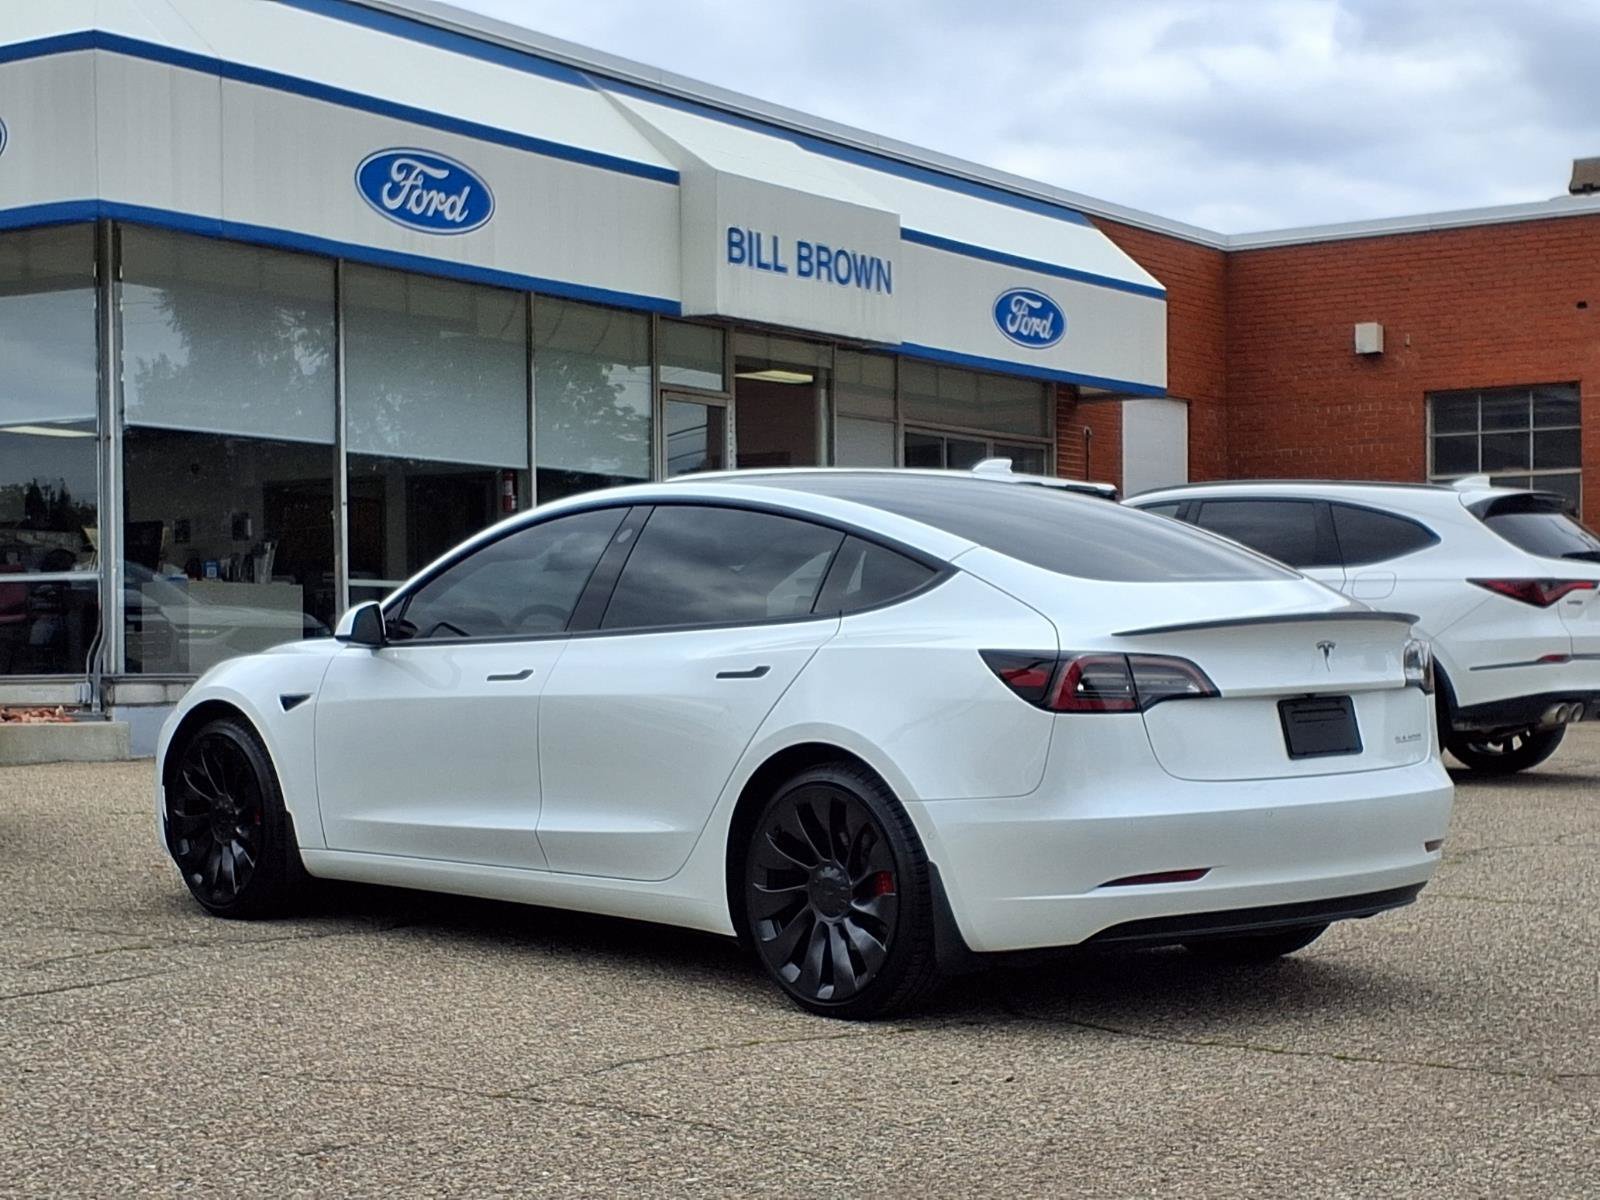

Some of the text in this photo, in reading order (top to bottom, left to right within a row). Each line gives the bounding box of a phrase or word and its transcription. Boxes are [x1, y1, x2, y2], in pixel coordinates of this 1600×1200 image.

[382, 158, 471, 223] Ford
[727, 226, 892, 295] BILL BROWN
[1006, 295, 1054, 340] Ford
